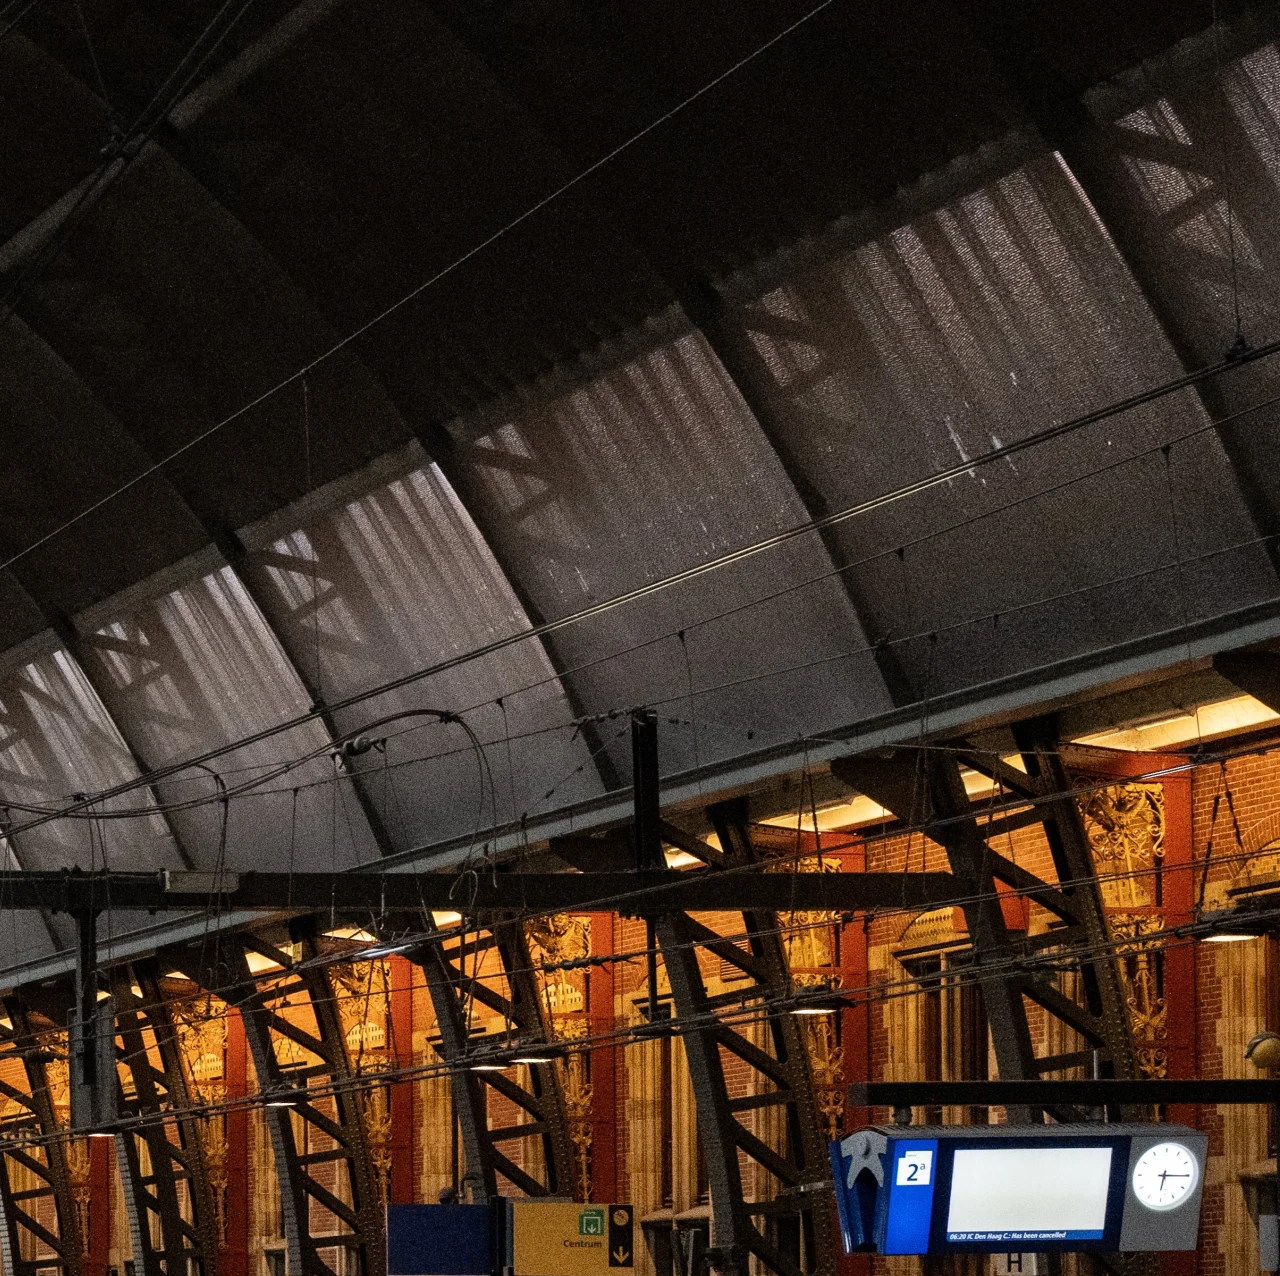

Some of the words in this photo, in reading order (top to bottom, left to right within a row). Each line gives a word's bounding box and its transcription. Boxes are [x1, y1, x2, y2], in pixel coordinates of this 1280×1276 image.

[987, 1233, 1002, 1241] Haag
[563, 1239, 602, 1248] Centrum
[1008, 1252, 1022, 1272] H
